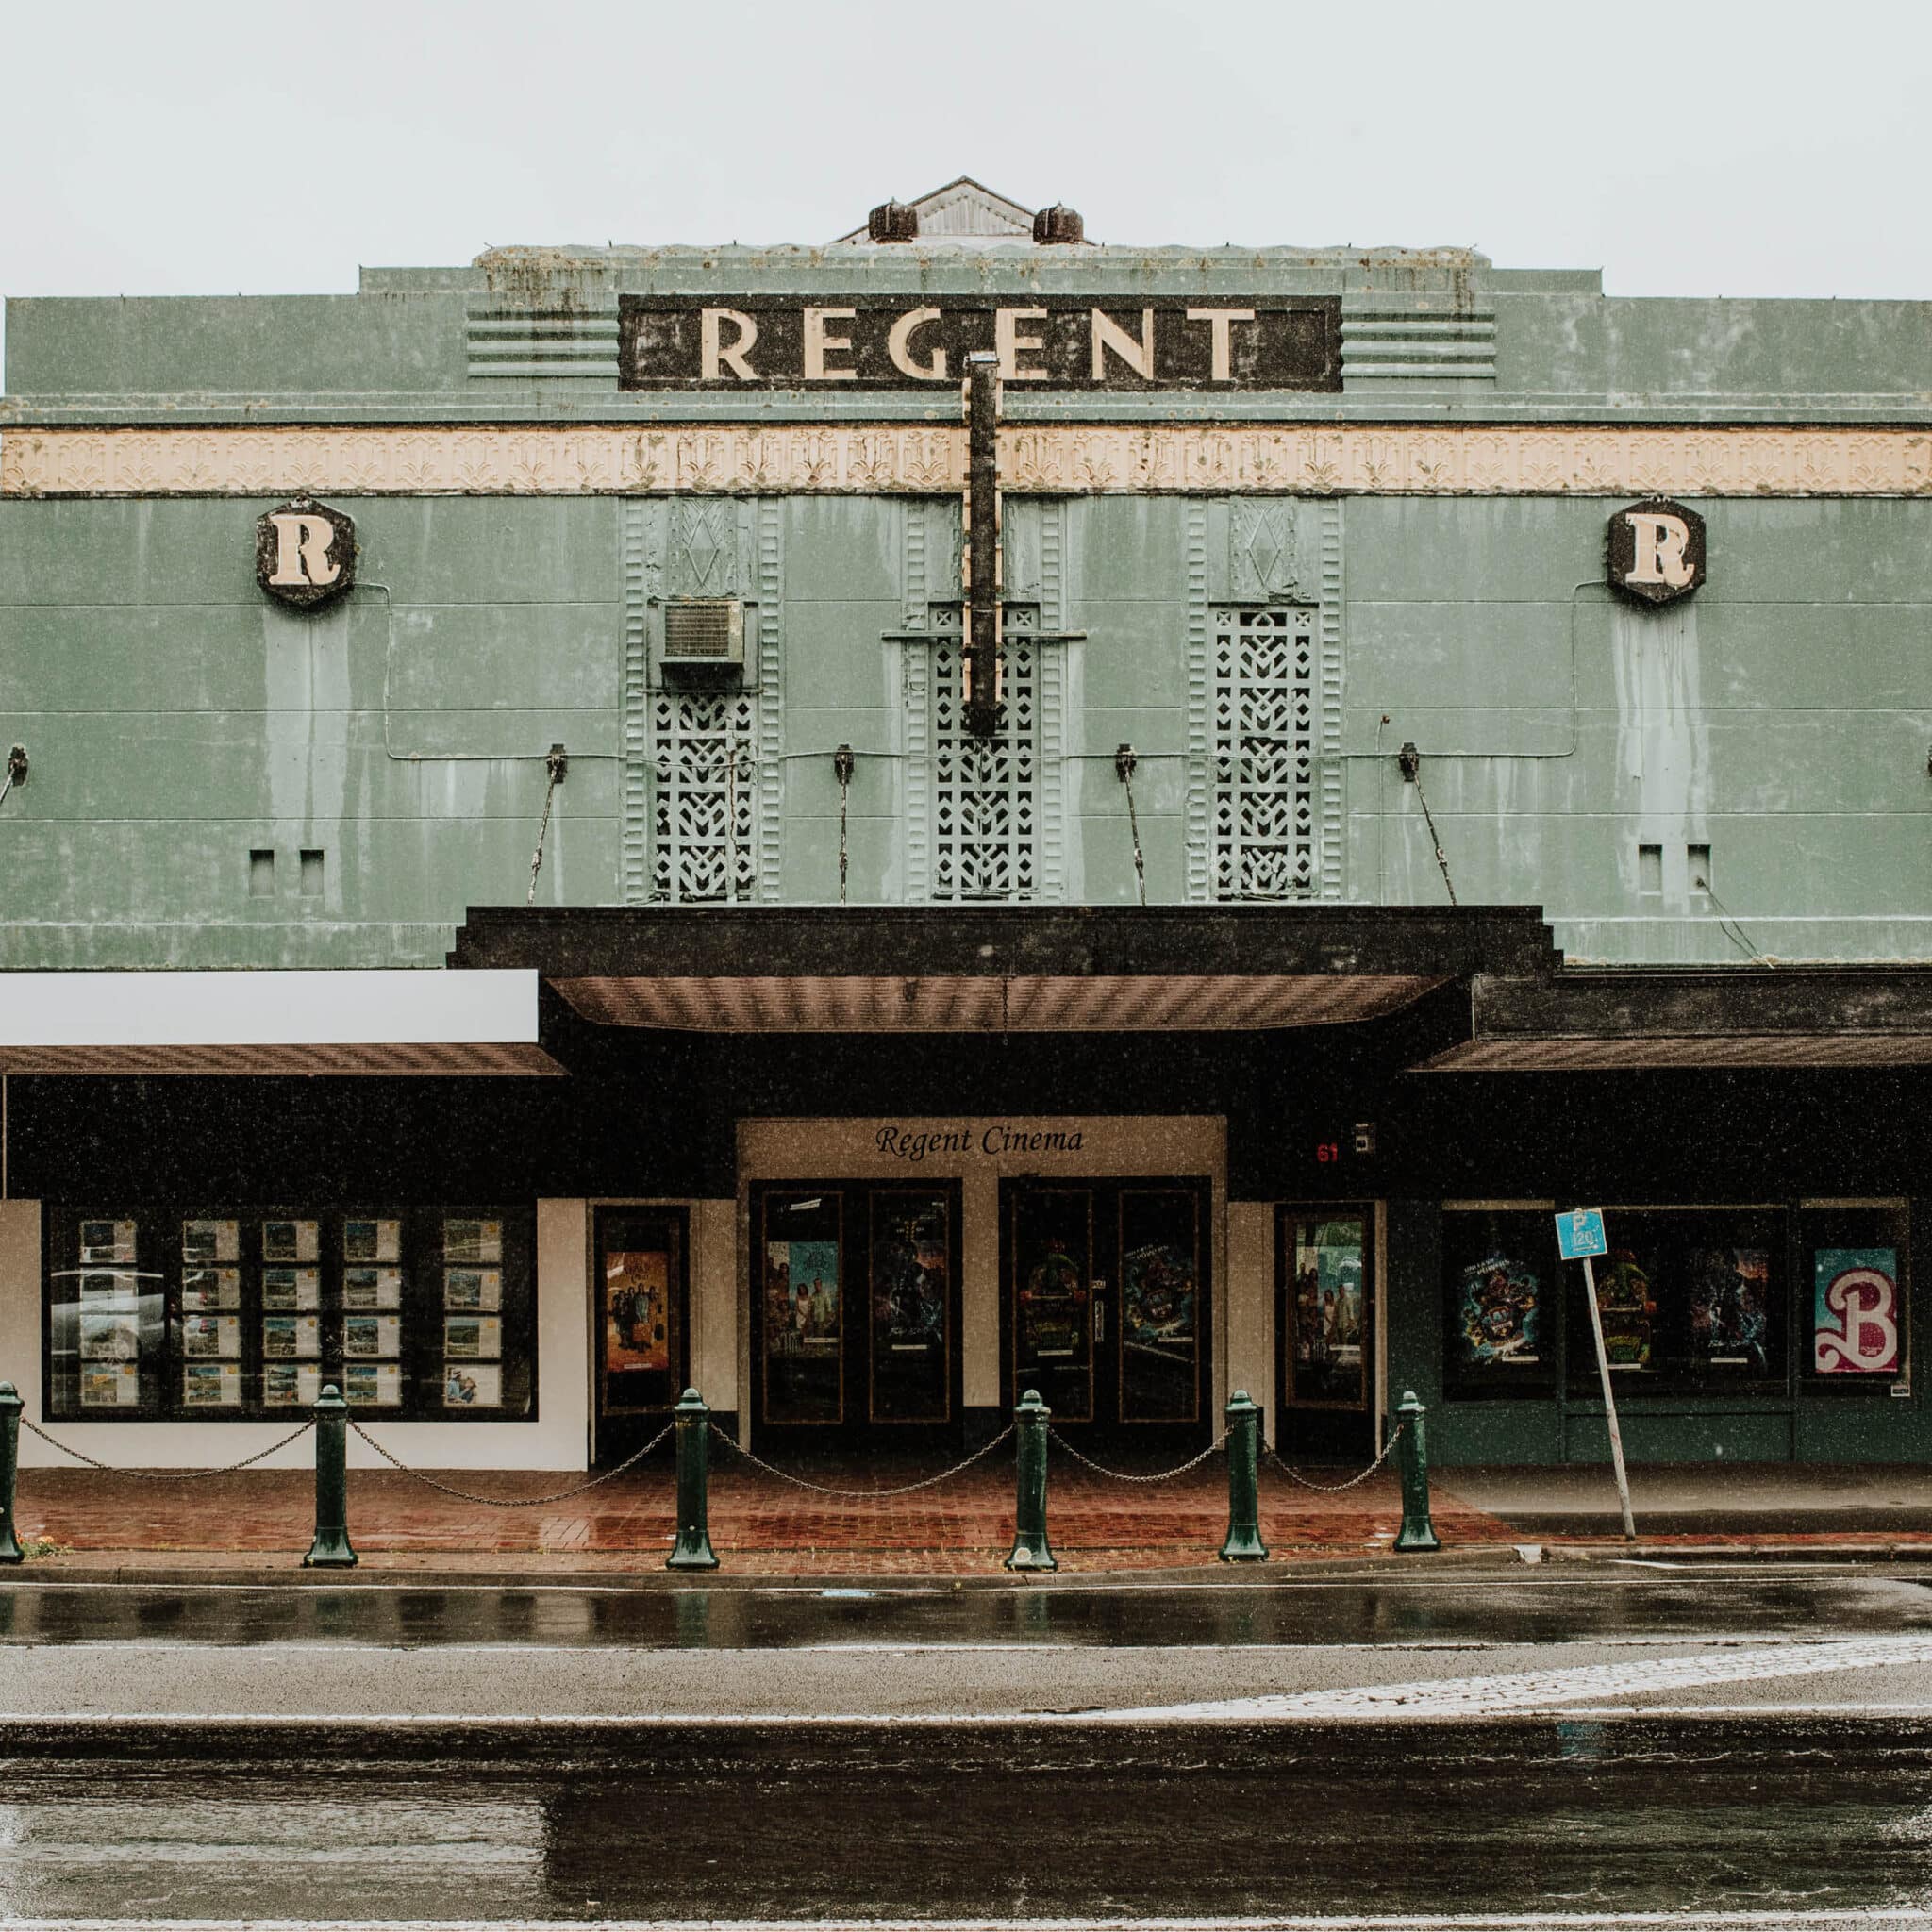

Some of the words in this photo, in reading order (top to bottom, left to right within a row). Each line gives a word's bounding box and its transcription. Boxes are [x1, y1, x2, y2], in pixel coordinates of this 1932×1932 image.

[700, 307, 1256, 383] REGENT
[268, 513, 341, 585] R
[1625, 512, 1695, 586] R
[875, 1126, 972, 1161] Regent
[981, 1125, 1084, 1155] Cinema
[1317, 1142, 1338, 1162] 61
[1573, 1213, 1587, 1231] P
